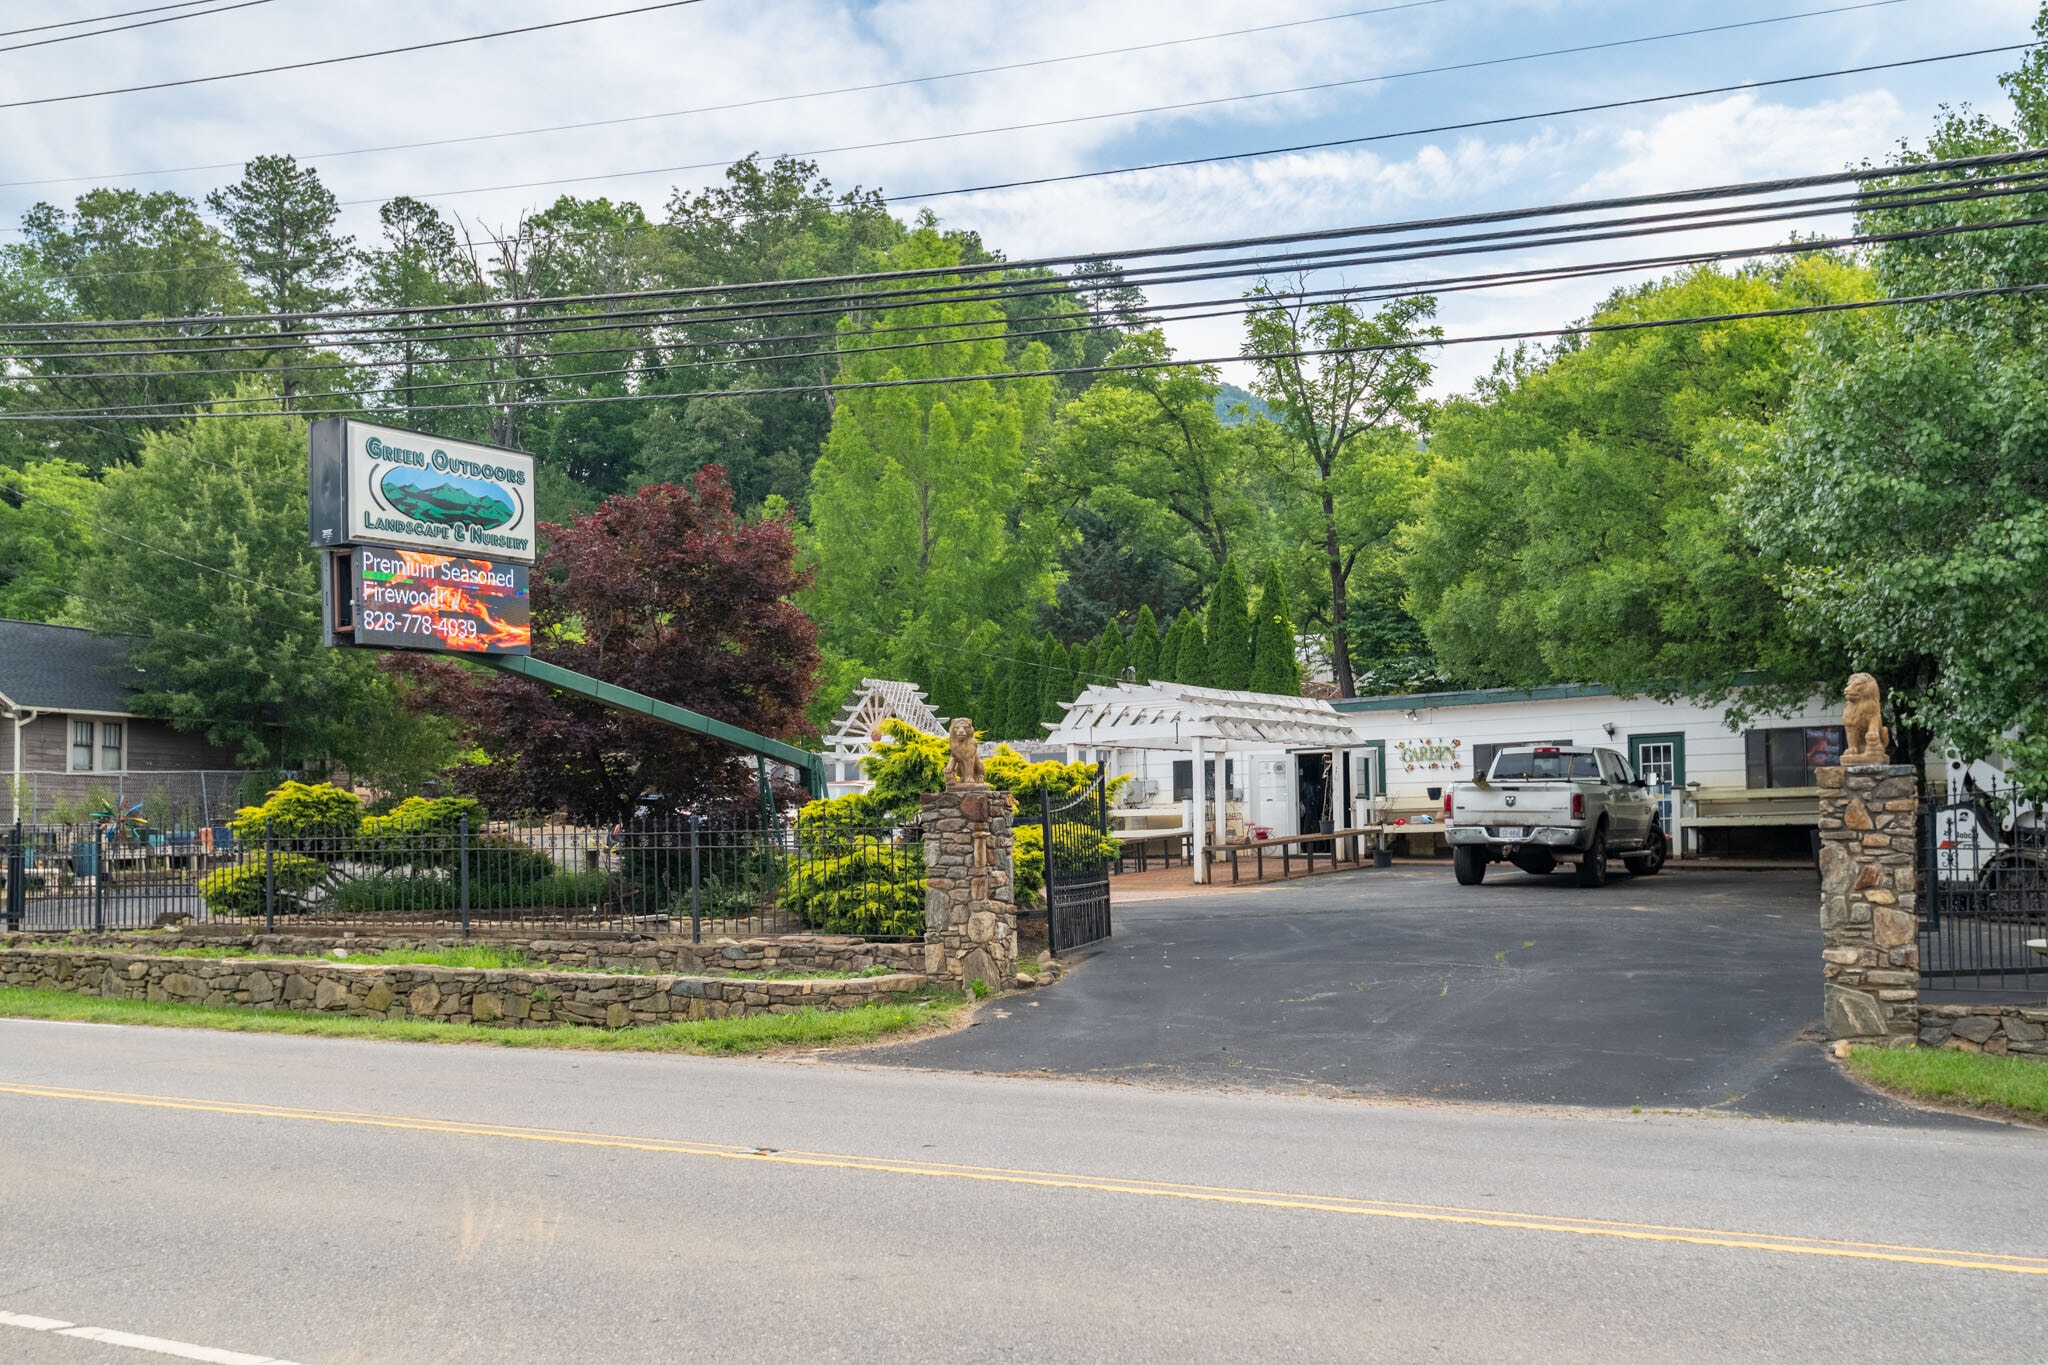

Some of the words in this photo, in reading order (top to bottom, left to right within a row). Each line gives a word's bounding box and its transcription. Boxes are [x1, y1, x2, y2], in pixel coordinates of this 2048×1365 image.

[366, 437, 424, 467] GREEN
[432, 449, 526, 485] OUTDOORS
[364, 511, 449, 539] LANDSCAPE
[454, 523, 466, 542] &
[470, 526, 528, 550] NURSERY
[363, 552, 434, 579] Premium
[441, 562, 514, 588] Seasoned
[363, 581, 447, 609] Firewood!
[363, 610, 477, 639] 828-778-4039
[1401, 745, 1456, 763] GARDEN
